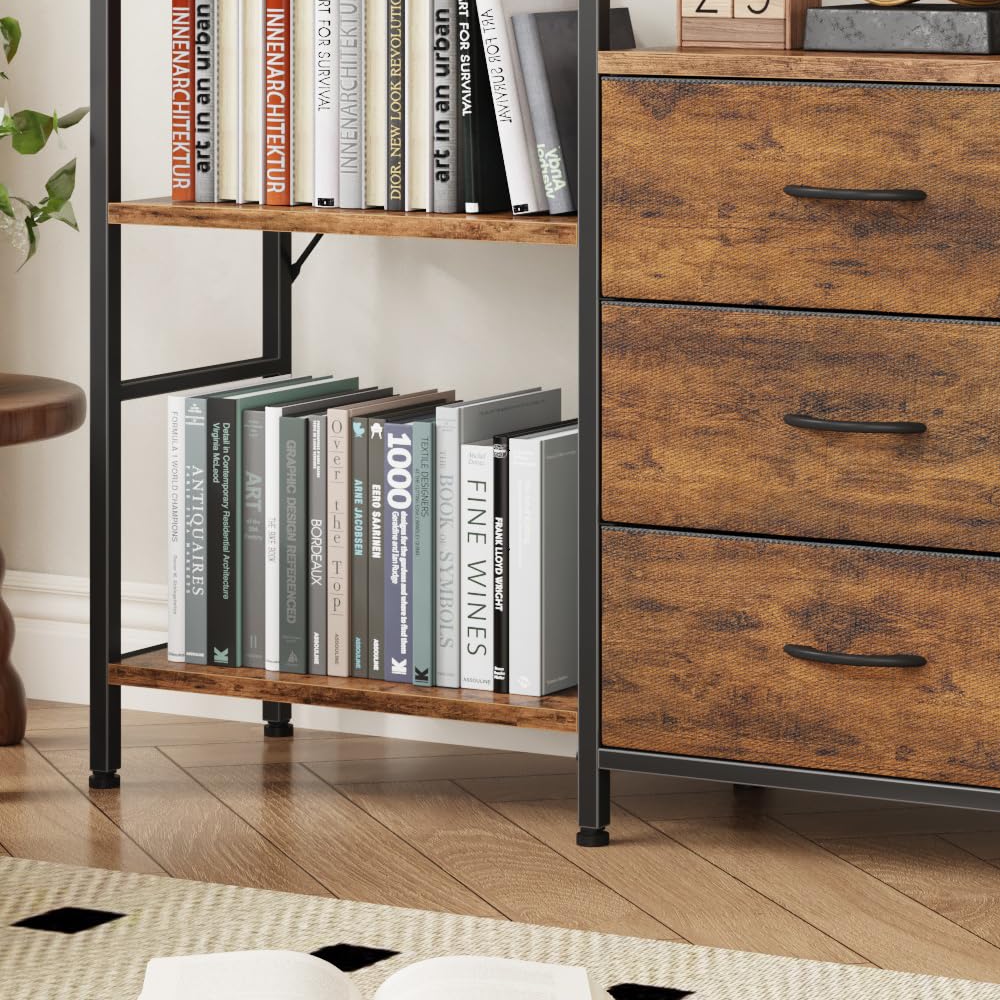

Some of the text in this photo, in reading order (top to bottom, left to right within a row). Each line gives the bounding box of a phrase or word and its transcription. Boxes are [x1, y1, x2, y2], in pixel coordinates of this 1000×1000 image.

[318, 21, 330, 46] FOR
[459, 24, 469, 51] FOR
[172, 6, 190, 189] INNENARCHITEKTUR
[195, 3, 210, 173] art in an urban
[266, 7, 285, 194] INNENARCHITEKTUR
[318, 51, 330, 112] SURVIVAL
[390, 79, 400, 120] LOOK
[433, 8, 449, 183] art in an urban
[460, 54, 472, 116] SURVIVAL
[390, 123, 400, 157] NEW
[170, 412, 179, 451] FORMULA
[211, 423, 220, 483] Virginia McLeod
[222, 423, 230, 444] Detail
[170, 459, 179, 490] WORLD
[221, 455, 230, 508] Contemporary
[246, 471, 262, 513] ART
[387, 433, 412, 509] 1000
[420, 437, 429, 517] TEXTILE DESIGNERS
[170, 493, 179, 542] CHAMPIONS
[354, 479, 363, 556] ARNE JACOBSEN
[372, 484, 381, 558] EERO SAARINEN
[399, 511, 408, 534] designs
[440, 474, 456, 529] BOOK
[467, 480, 487, 546] FINE
[190, 465, 204, 596] ANTIQUAIRES
[222, 511, 230, 552] Residential
[286, 440, 297, 623] GRAPHIC DESIGN REFERENCED
[310, 519, 323, 585] BORDEAUX
[401, 536, 409, 545] for
[440, 534, 447, 545] OF
[222, 554, 230, 600] Architecture
[391, 565, 399, 584] Rudge
[494, 517, 503, 612] FRANK LLOYD WRIGHT
[439, 551, 454, 649] SYMBOLS
[467, 559, 487, 657] WINES
[401, 624, 409, 636] find
